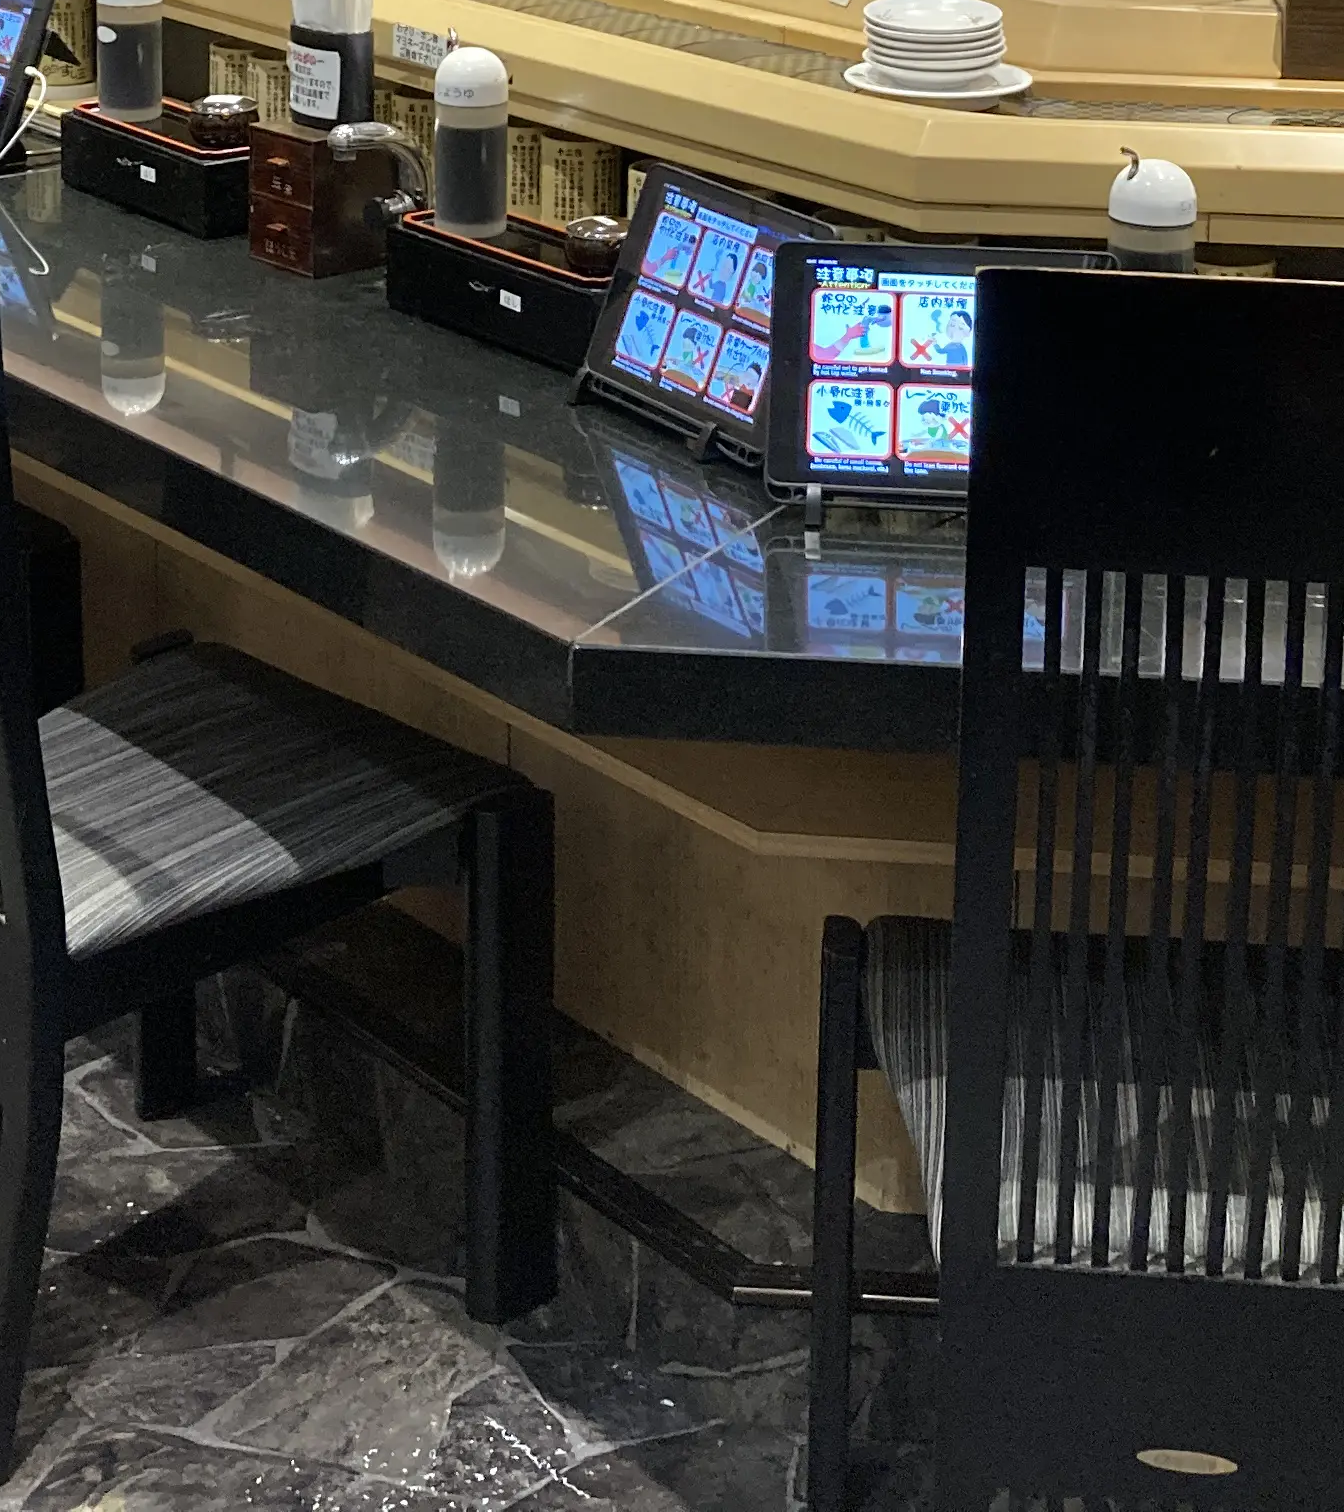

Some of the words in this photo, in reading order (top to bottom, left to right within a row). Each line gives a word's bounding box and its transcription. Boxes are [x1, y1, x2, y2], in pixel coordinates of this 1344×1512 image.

[816, 267, 875, 283] 注意事項
[919, 296, 968, 309] 店内禁煙
[906, 389, 958, 401] レーンへの
